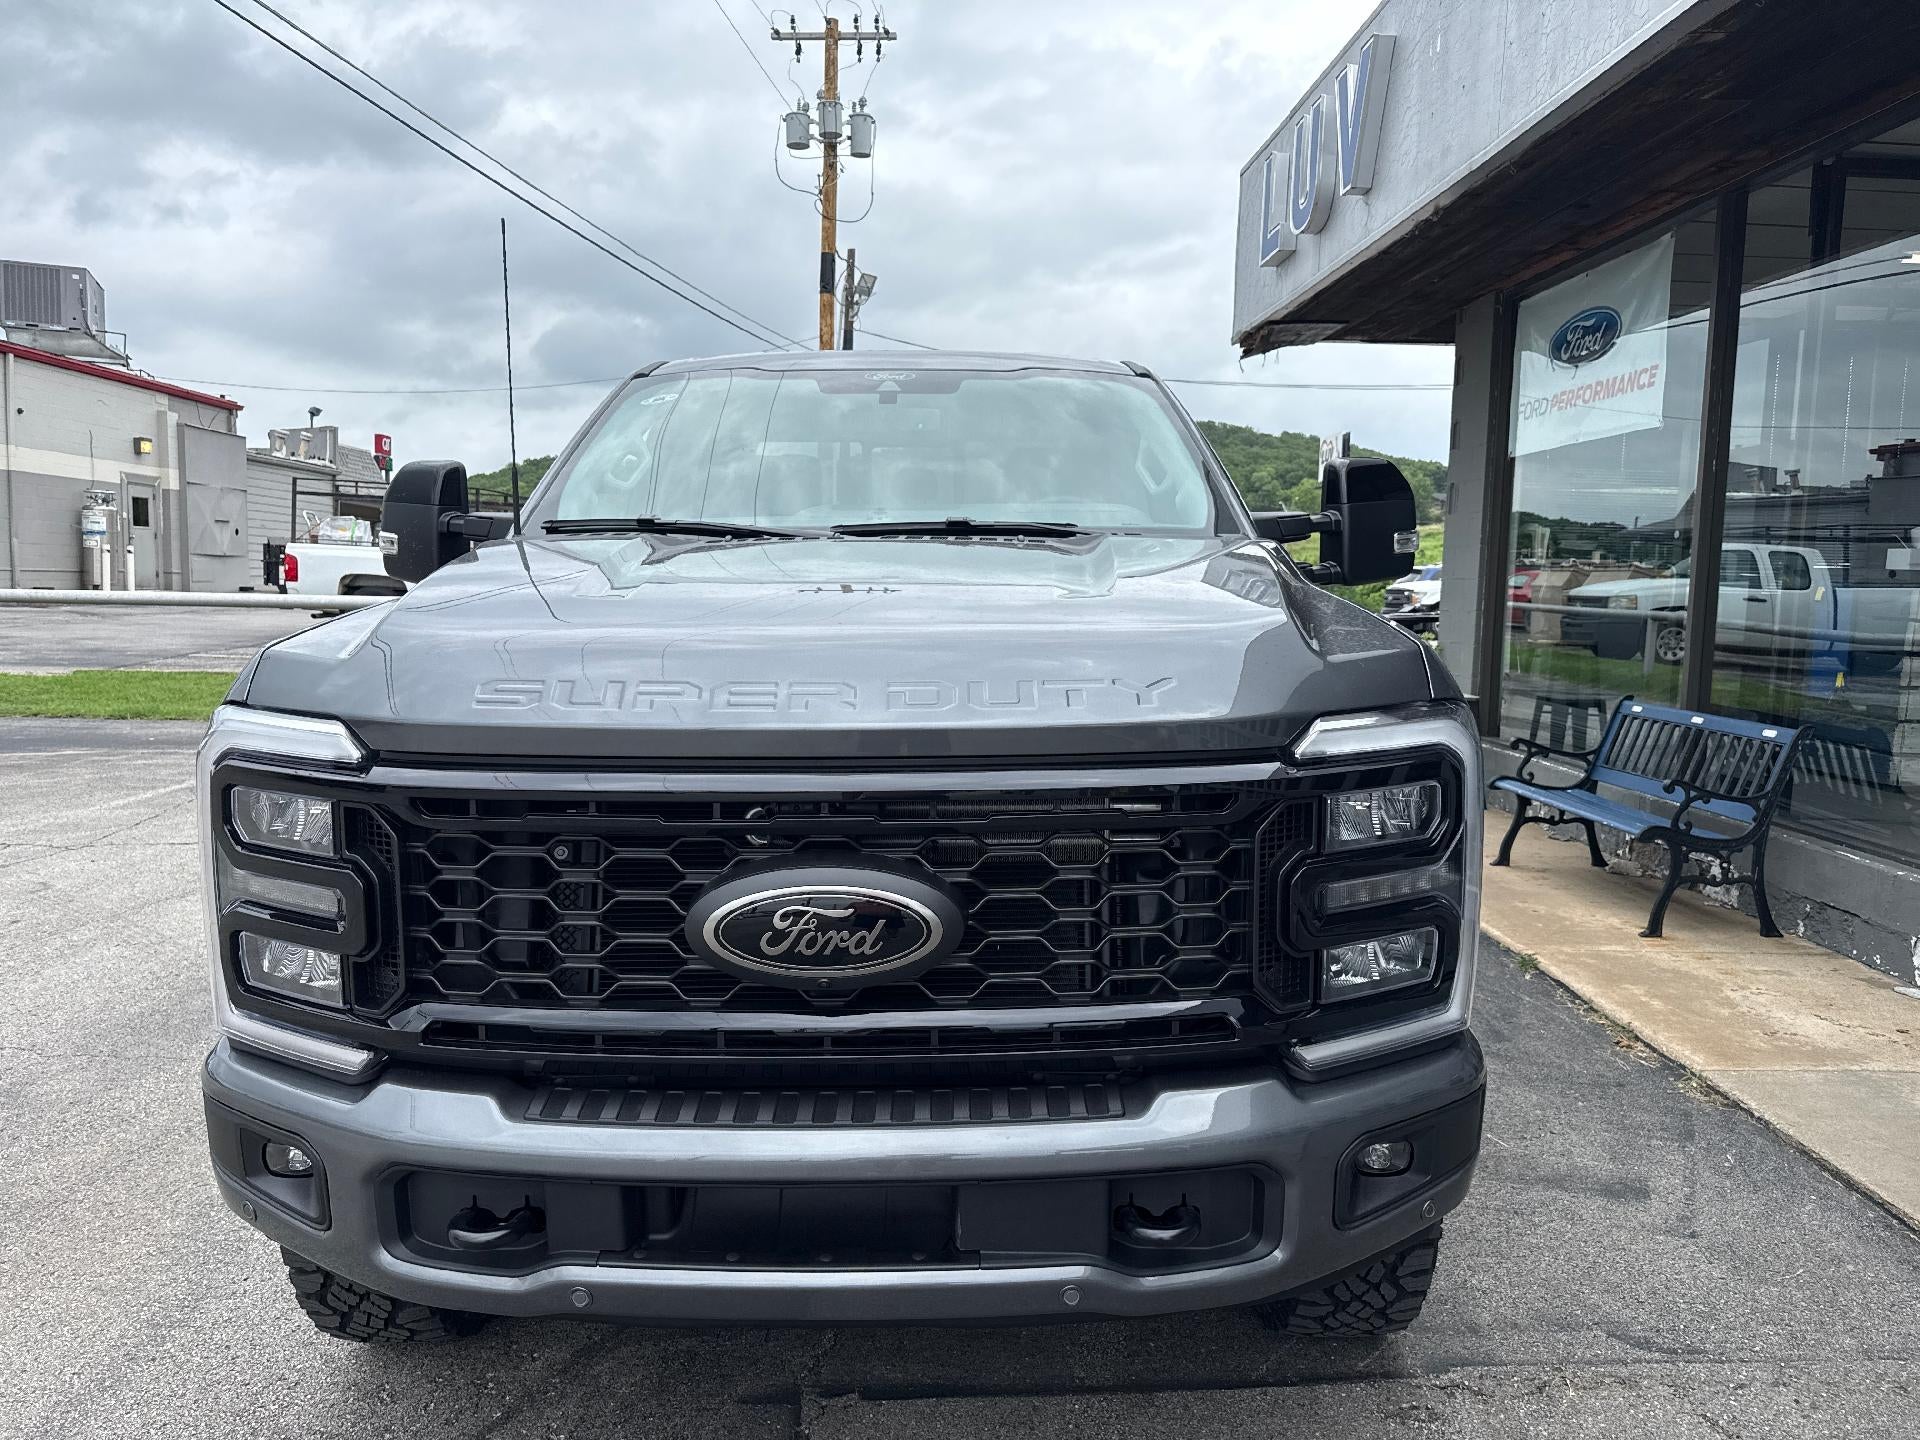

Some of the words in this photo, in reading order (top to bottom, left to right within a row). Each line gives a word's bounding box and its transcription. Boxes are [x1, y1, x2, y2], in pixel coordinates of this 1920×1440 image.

[1259, 33, 1396, 267] LUV
[1561, 317, 1607, 361] Ford
[1518, 397, 1549, 422] FORD
[1550, 363, 1660, 414] PERFORMANCE
[472, 679, 858, 713] SUPER
[886, 676, 1177, 712] DUTY
[760, 905, 887, 956] Ford
